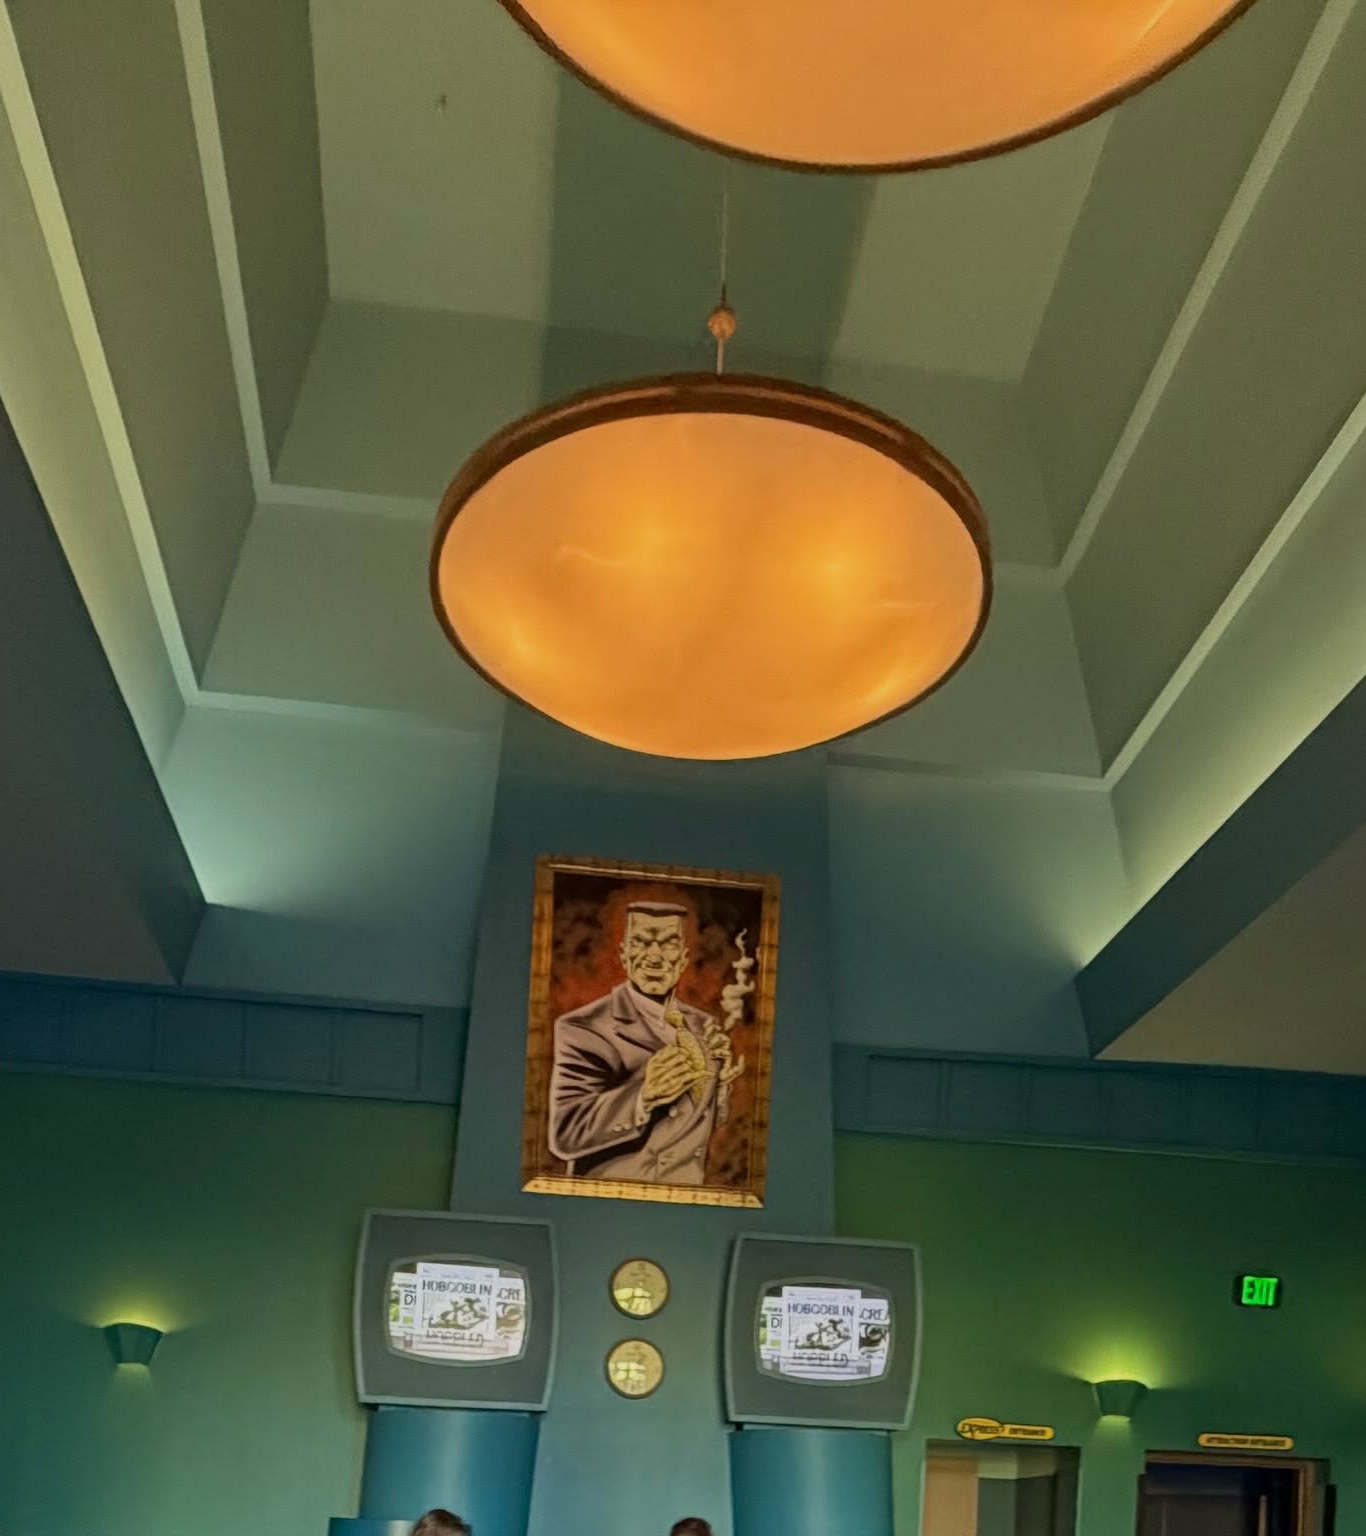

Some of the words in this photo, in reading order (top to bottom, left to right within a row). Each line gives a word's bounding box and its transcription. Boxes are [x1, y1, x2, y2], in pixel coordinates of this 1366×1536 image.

[422, 1279, 493, 1296] HOBGOBLIN
[1241, 1275, 1278, 1306] EXIT
[788, 1302, 855, 1317] HOBGOBLIN
